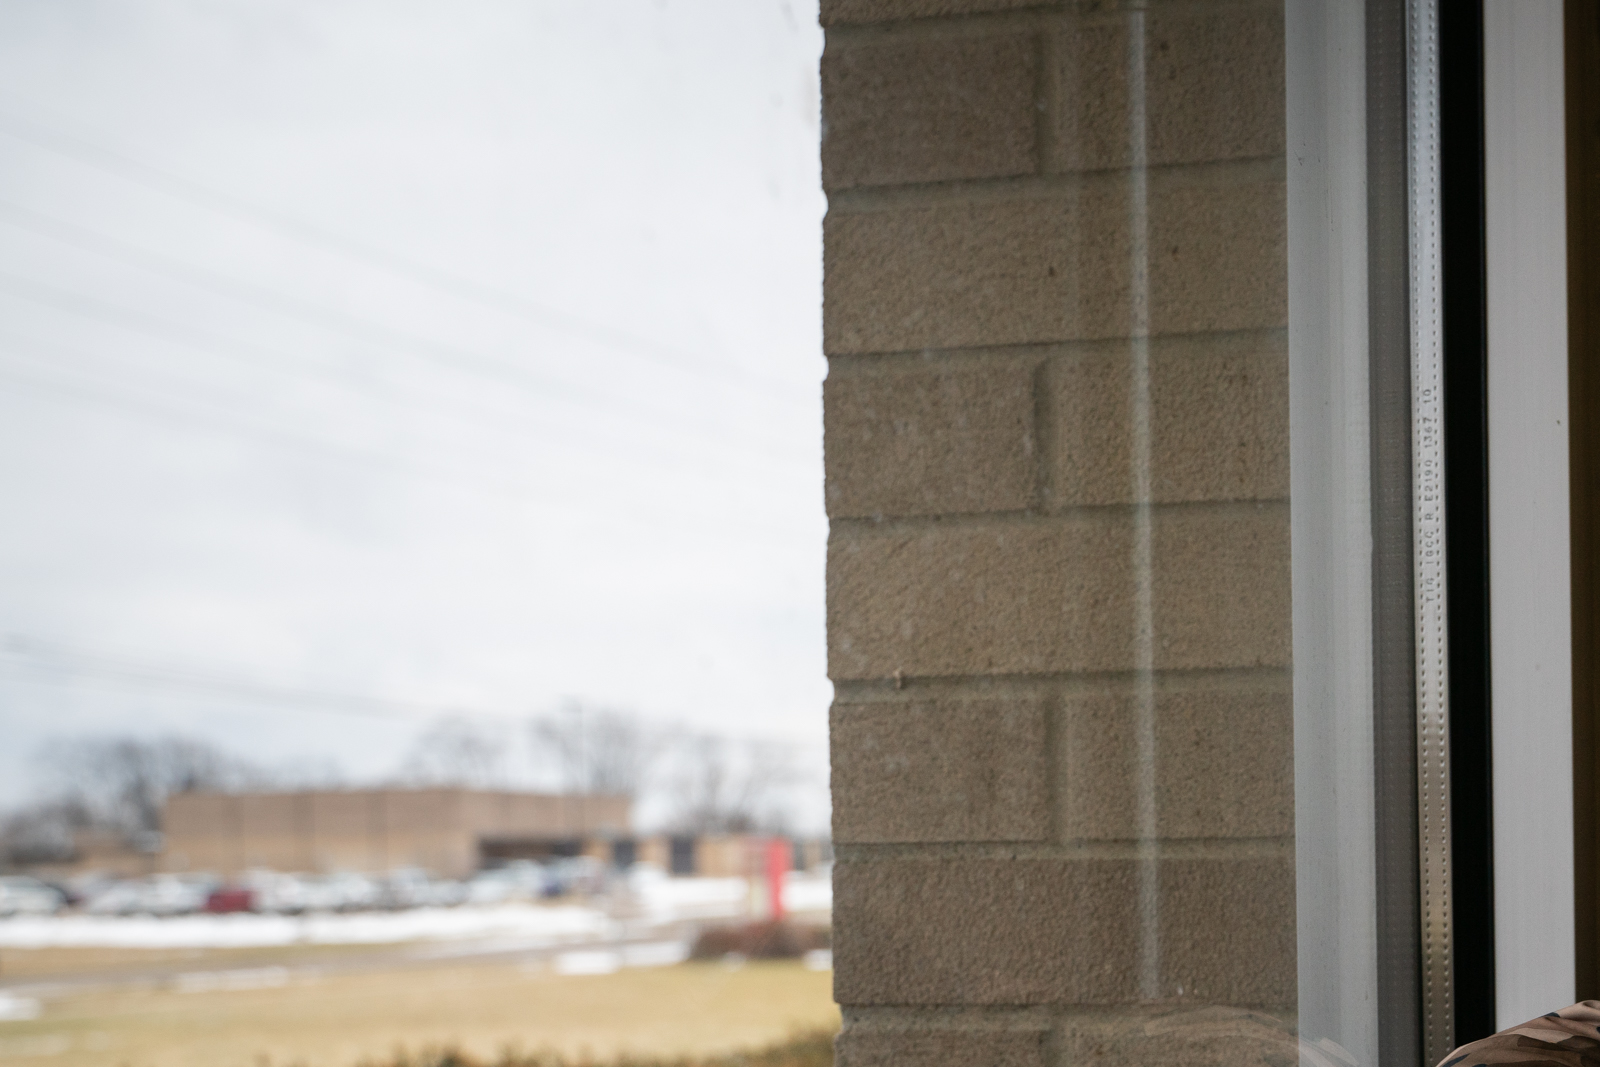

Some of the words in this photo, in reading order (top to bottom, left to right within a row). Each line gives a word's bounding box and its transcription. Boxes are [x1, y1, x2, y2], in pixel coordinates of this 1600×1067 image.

[1423, 388, 1432, 405] 10
[1423, 416, 1433, 449] 1367
[1424, 512, 1434, 521] R
